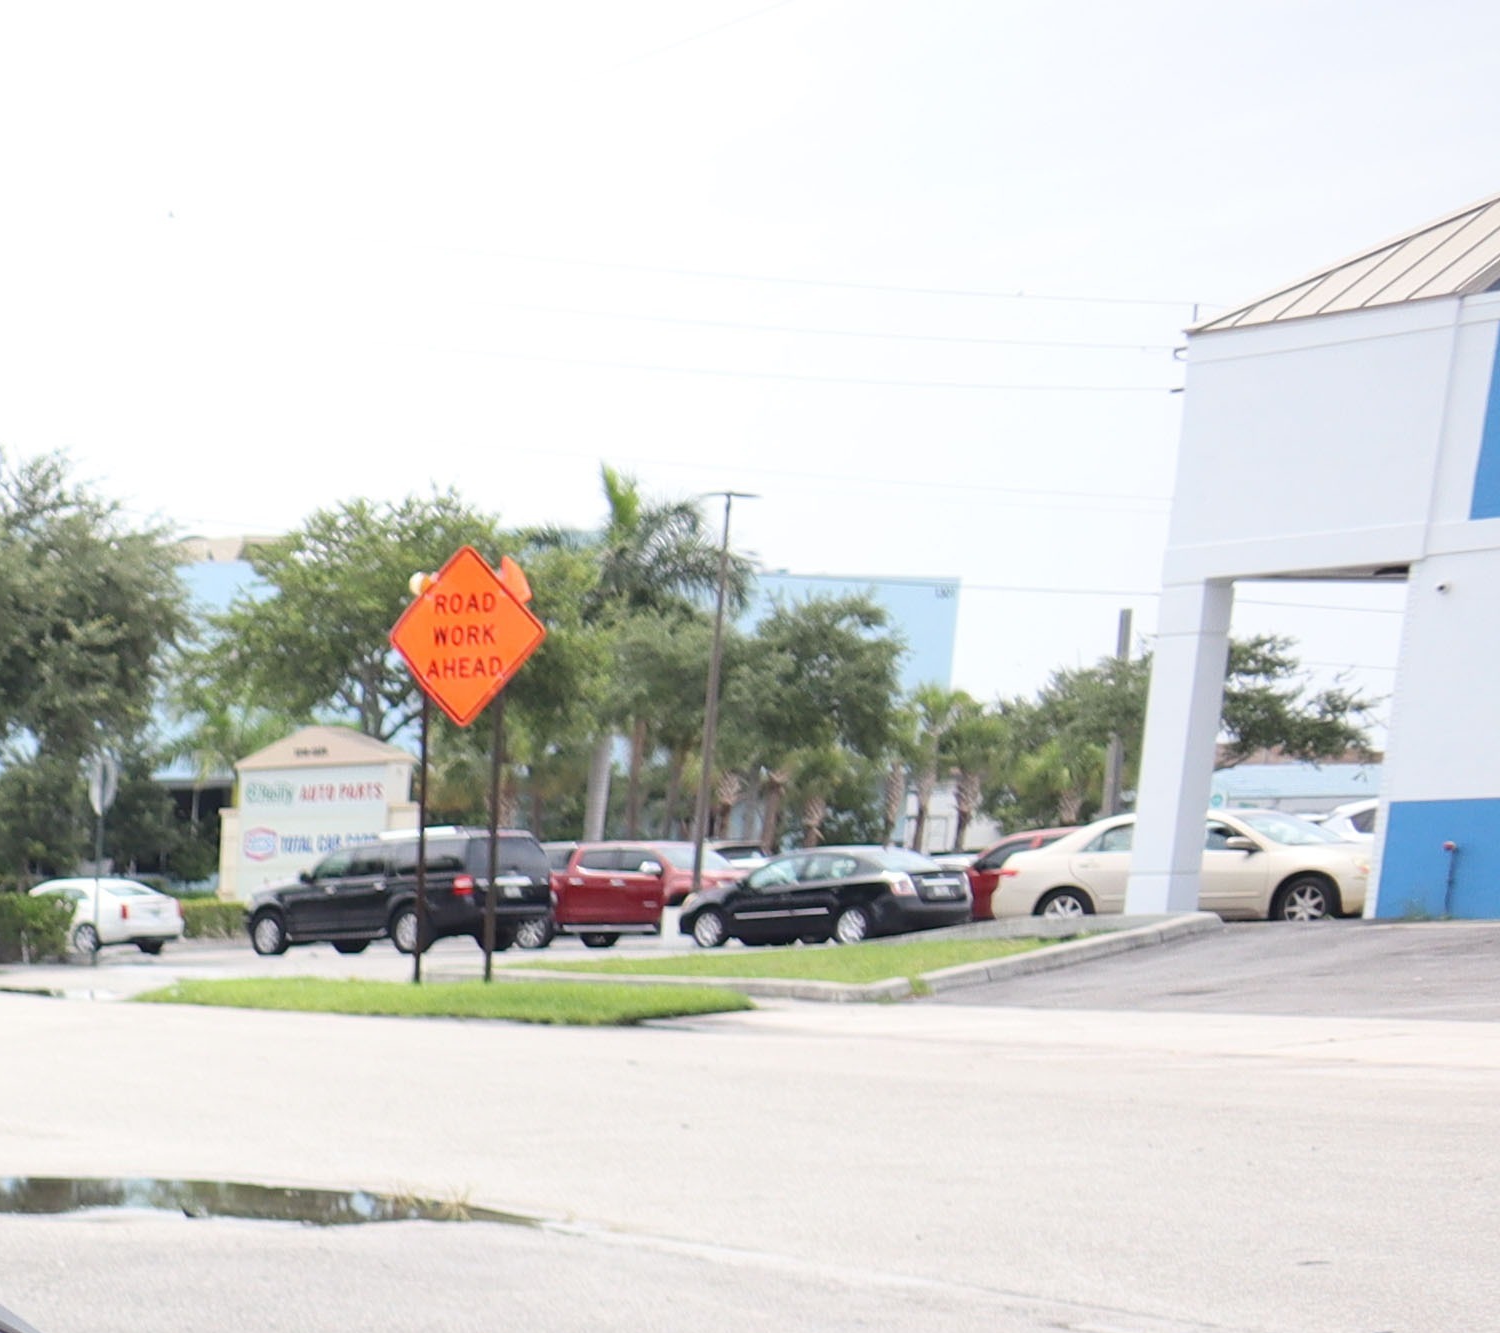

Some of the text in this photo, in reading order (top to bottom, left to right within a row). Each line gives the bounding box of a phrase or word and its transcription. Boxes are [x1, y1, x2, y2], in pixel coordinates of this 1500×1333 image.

[434, 592, 496, 614] ROAD
[433, 624, 496, 647] WORK
[426, 655, 503, 679] AHEAD
[299, 783, 336, 801] AUTO
[338, 781, 385, 800] PARTS
